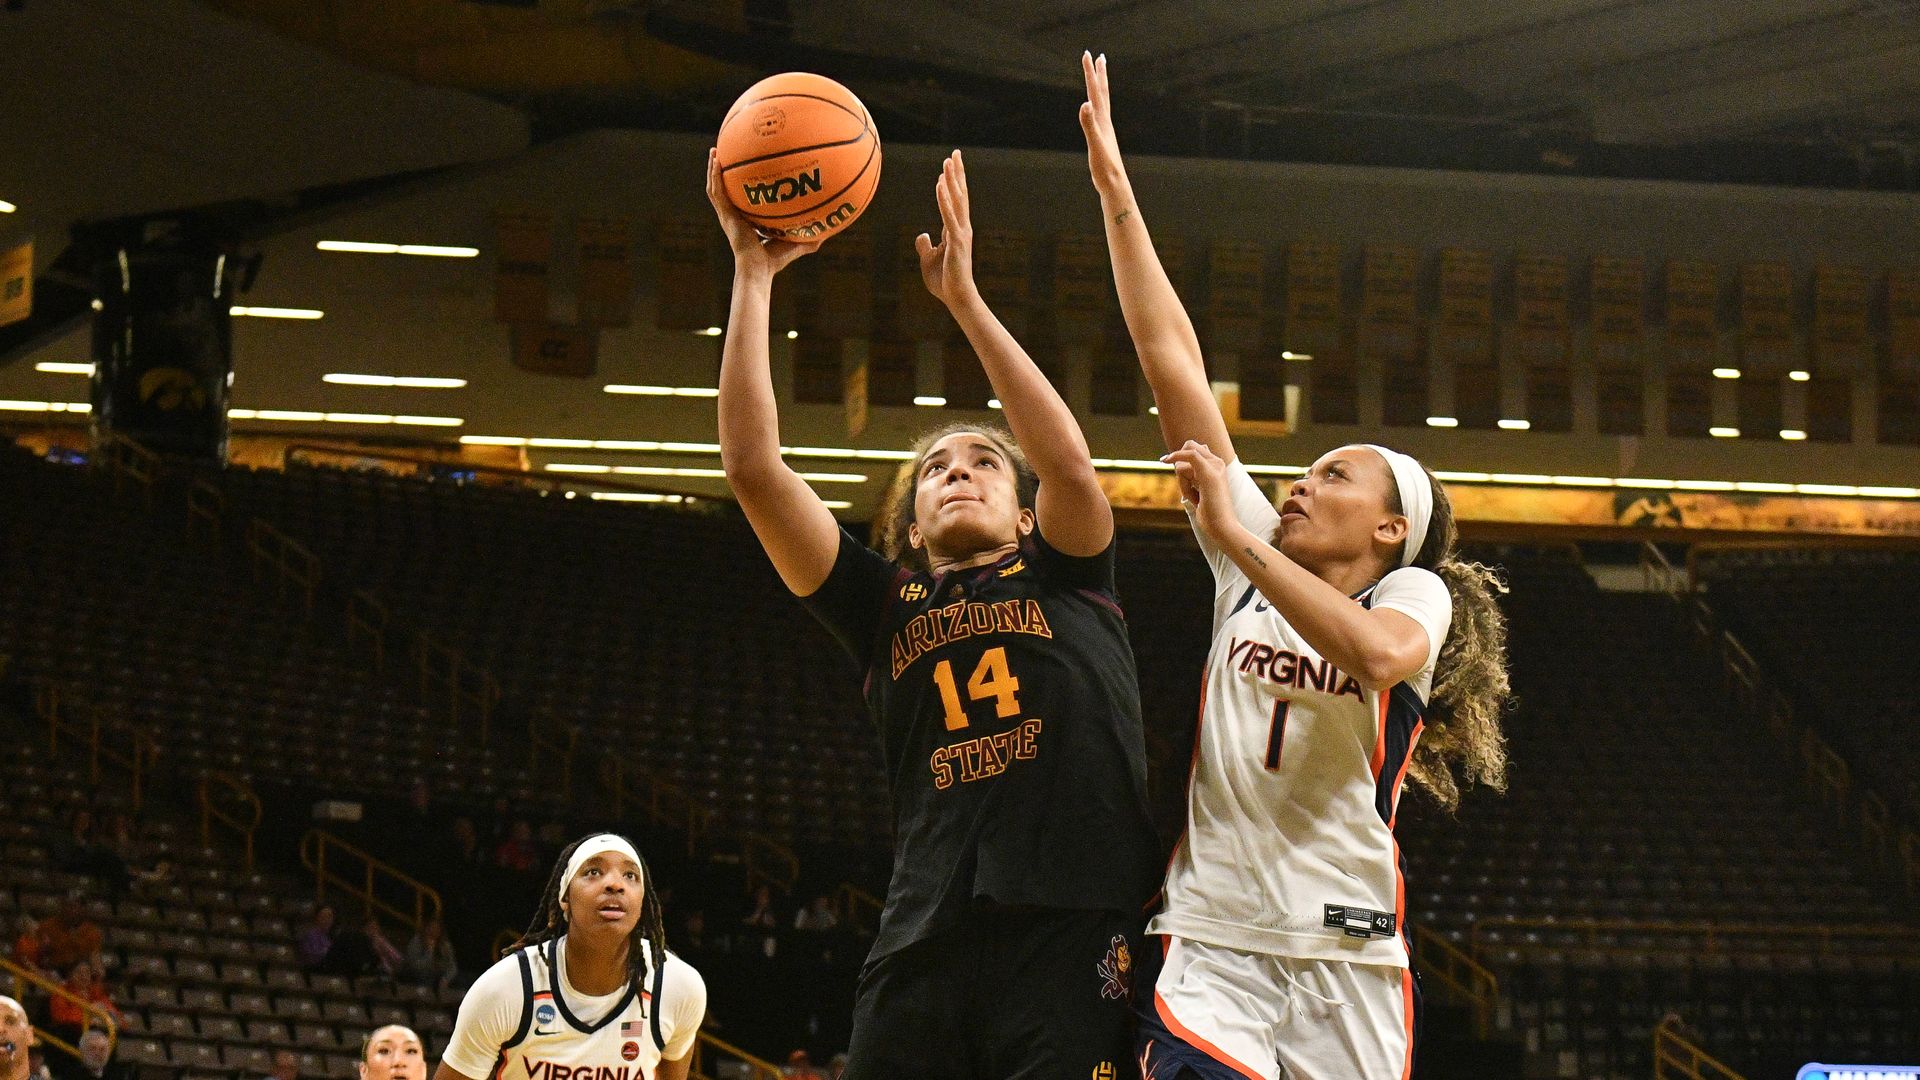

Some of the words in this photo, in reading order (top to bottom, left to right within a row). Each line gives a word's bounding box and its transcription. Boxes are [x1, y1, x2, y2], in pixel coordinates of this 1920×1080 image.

[743, 168, 822, 205] NCAA
[892, 599, 1053, 680] ARIZONA
[933, 646, 1021, 731] 14
[930, 718, 1042, 789] STATE
[1264, 697, 1291, 772] 1
[1376, 917, 1388, 928] 42
[522, 1055, 646, 1080] VIRGINIA
